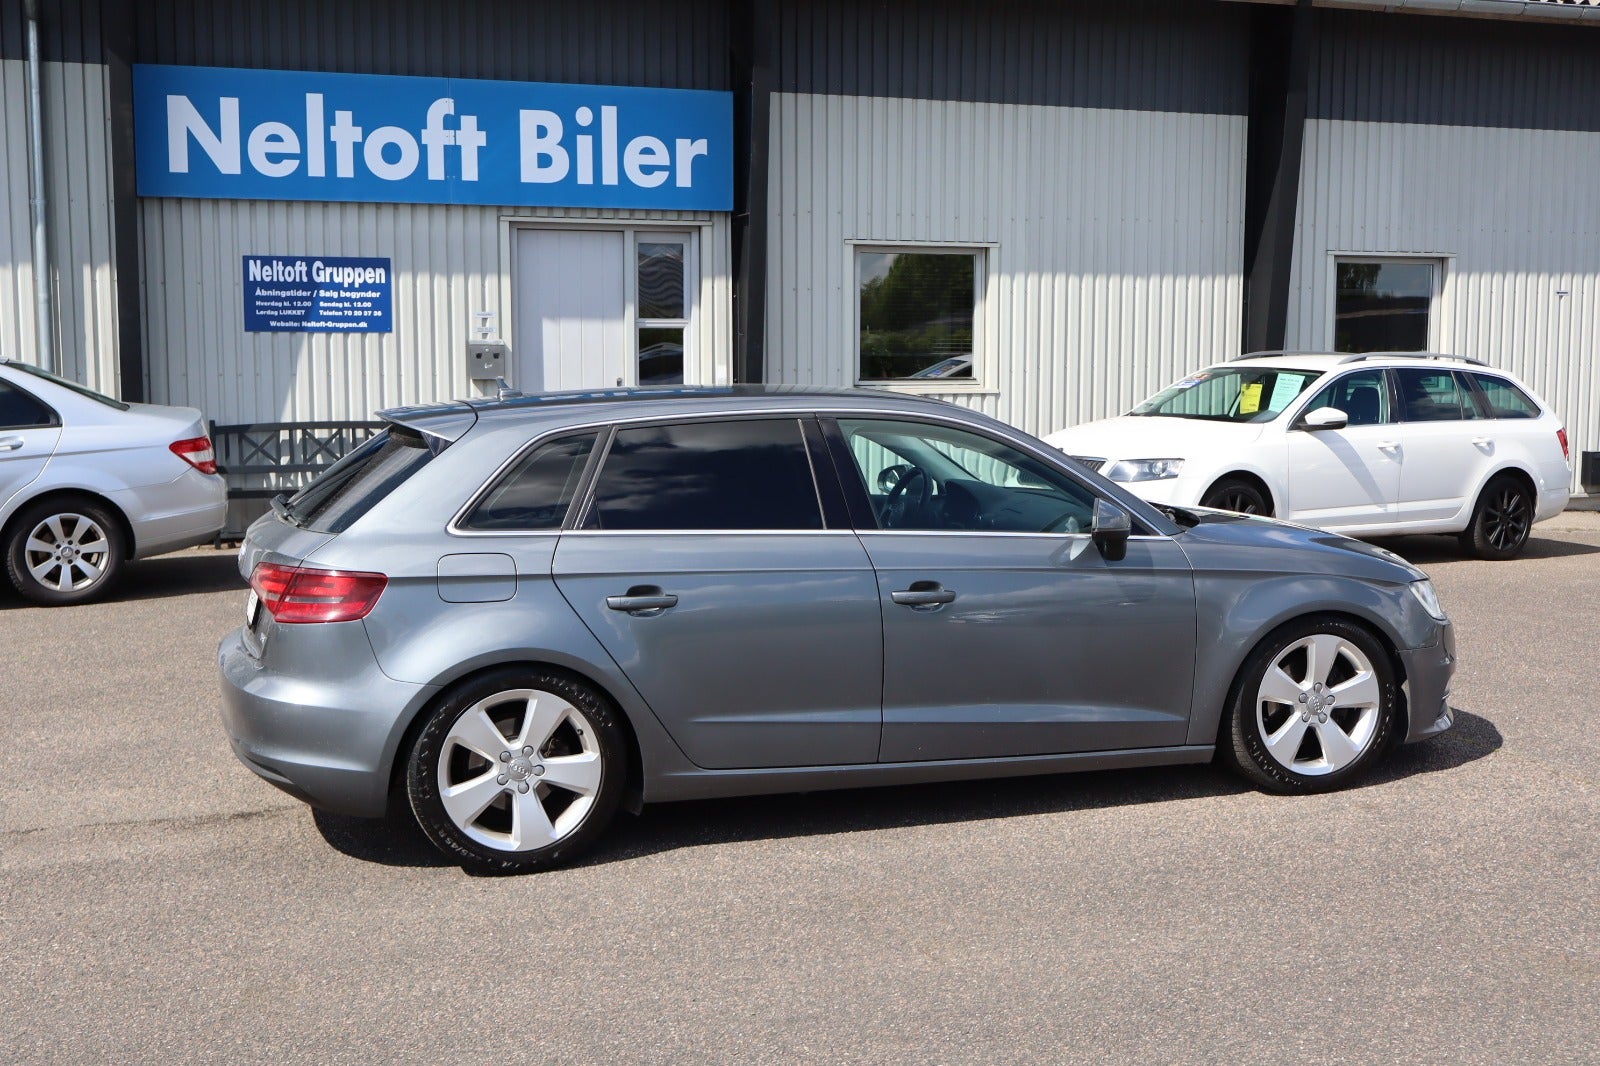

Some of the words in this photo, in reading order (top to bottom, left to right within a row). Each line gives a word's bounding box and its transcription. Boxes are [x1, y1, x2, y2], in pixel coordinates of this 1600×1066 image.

[167, 93, 487, 182] Neltoft
[520, 105, 708, 188] Biler
[248, 259, 308, 283] Neltoft
[312, 260, 386, 288] Gruppen
[255, 287, 312, 297] Åbningstider
[319, 290, 338, 298] Salg
[340, 290, 381, 298] begynder
